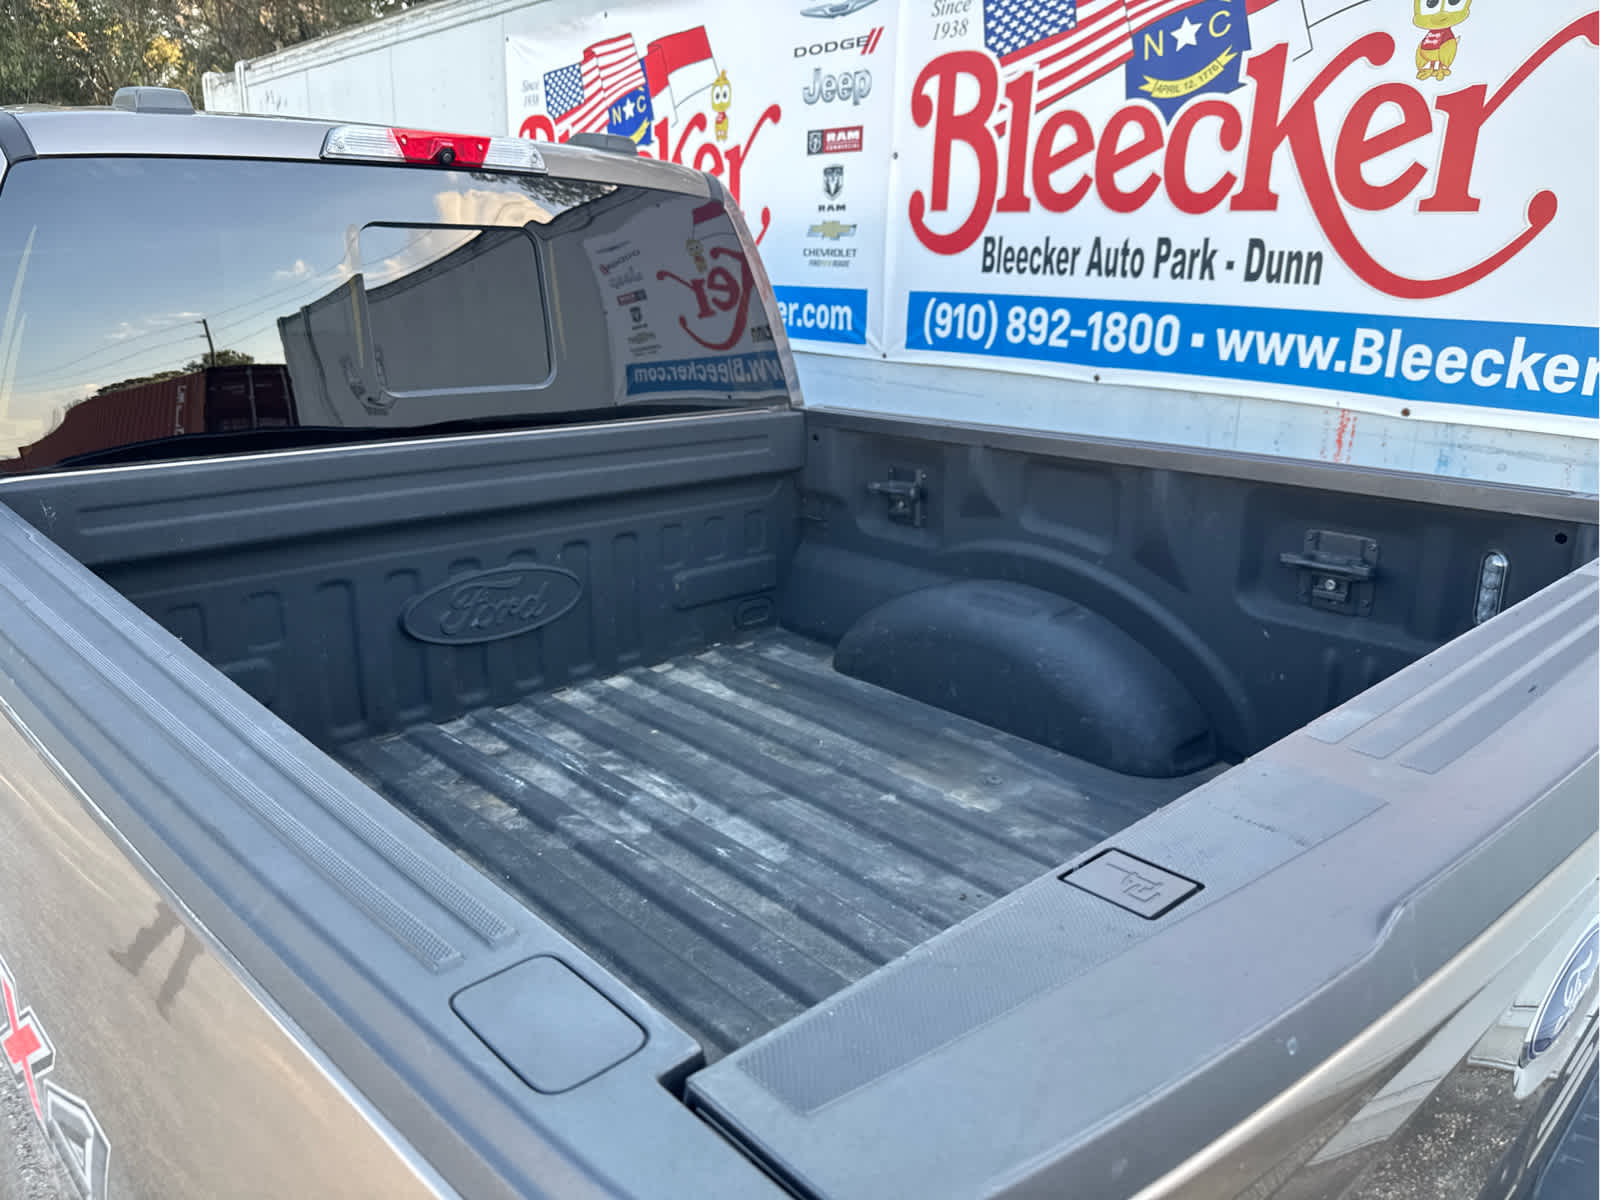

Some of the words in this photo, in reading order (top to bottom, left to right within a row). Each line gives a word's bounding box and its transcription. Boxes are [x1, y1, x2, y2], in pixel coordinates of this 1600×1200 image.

[931, 0, 971, 17] Since
[932, 18, 969, 40] 1938
[1144, 30, 1163, 60] N
[1209, 10, 1231, 37] C
[793, 34, 870, 58] DODGE
[802, 67, 873, 106] Jeep
[826, 131, 860, 142] RAM
[818, 204, 847, 212] RAM
[803, 248, 857, 258] CHEVROLET
[981, 236, 1081, 277] Bleecker
[1085, 237, 1145, 279] Auto
[1153, 237, 1219, 281] Park
[1243, 238, 1324, 286] Dunn
[923, 297, 998, 350] (910)
[1006, 305, 1181, 357] 892-1800
[439, 575, 549, 636] Ford
